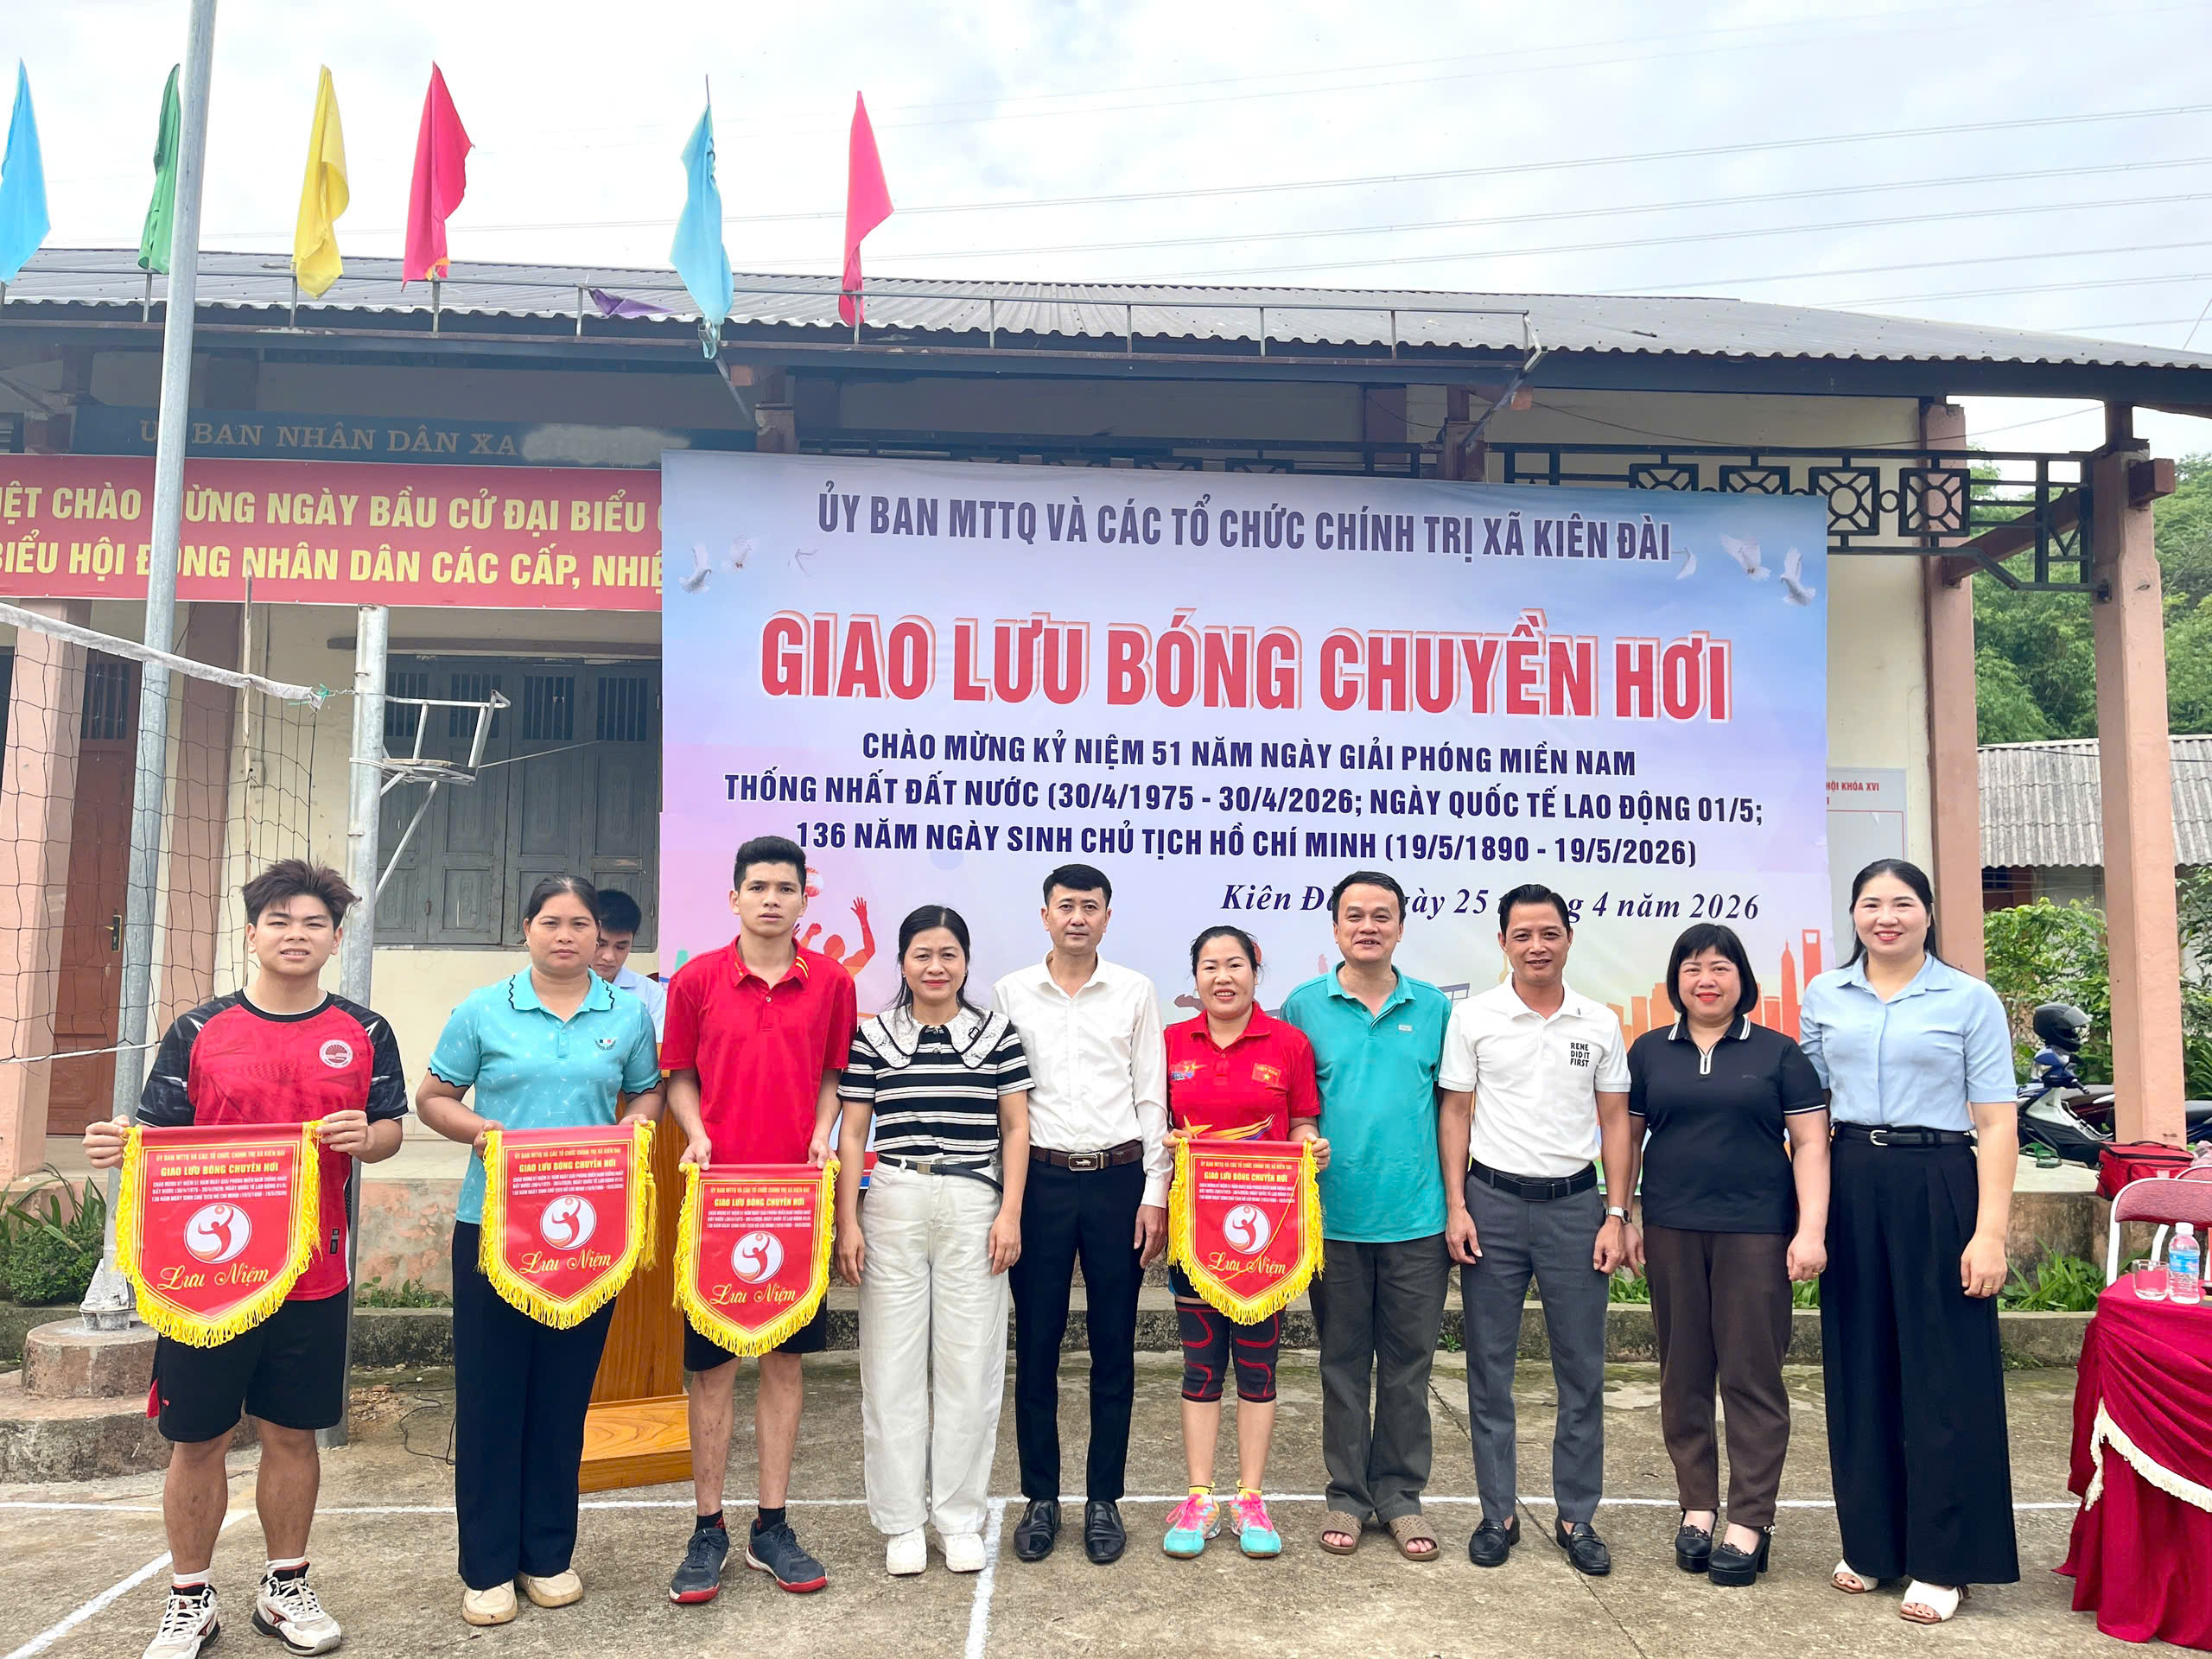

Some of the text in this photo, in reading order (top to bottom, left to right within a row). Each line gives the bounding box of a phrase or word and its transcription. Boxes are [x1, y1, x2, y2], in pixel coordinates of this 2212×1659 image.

[140, 420, 158, 442] U
[192, 423, 264, 446] BAN
[276, 422, 377, 450] NHÂN
[387, 423, 461, 454] DÂN
[0, 480, 42, 524] ỆT
[52, 481, 142, 521] CHÀO
[180, 484, 255, 523] ỪNG
[267, 487, 359, 526] NGÀY
[370, 486, 436, 529] BẦU
[448, 487, 497, 530] CỬ
[504, 499, 559, 537] ĐẠI
[570, 489, 646, 533] BIỂU
[819, 480, 1669, 563] ỦY BAN MTTQ VÀ CÁC TỔ CHỨC CHÍNH TRỊ XÃ KIÊN ĐÀI
[0, 529, 59, 574] IỂU
[69, 537, 124, 581] HỘI
[136, 543, 231, 578] ĐNG
[242, 541, 339, 581] NHÂN
[350, 543, 422, 582] DÂN
[432, 546, 498, 584] CÁC
[510, 543, 581, 589] CẤP,
[760, 608, 1732, 720] GIAO LƯU BÓNG CHUYỀN HƠI
[863, 728, 1635, 775] CHÀO MỪNG KỶ NIỆM 51 NĂM NGÀY GIẢI PHÓNG MIỀN NAM
[725, 766, 816, 802] THỐNG
[826, 769, 898, 804] NHẤT
[906, 771, 957, 804] ĐẤT
[965, 776, 1038, 807] NƯỚC
[1049, 783, 1193, 810] (30/4/1975
[1219, 786, 1361, 817] 30/4/2026;
[1370, 785, 1440, 815] NGÀY
[1450, 783, 1518, 818] QUỐC
[1527, 785, 1557, 817] TẾ
[1565, 794, 1611, 819] LAO
[1619, 791, 1689, 825] ĐỘNG
[1699, 798, 1761, 825] 01/5;
[1841, 781, 1864, 791] KHÓA
[1866, 782, 1879, 791] XVI
[798, 823, 845, 848] 136
[855, 818, 917, 849] NĂM
[926, 820, 999, 850] NGÀY
[1007, 826, 1071, 852] SINH
[1082, 820, 1133, 854] CHỦ
[1142, 830, 1201, 860] TỊCH
[1211, 823, 1243, 855] HỒ
[1254, 827, 1297, 856] CHÍ
[1306, 832, 1375, 858] MINH
[1386, 834, 1529, 861] (19/5/1890
[1555, 838, 1695, 868] 19/5/2026)
[1221, 885, 1290, 910] Kiên
[1404, 887, 1446, 920] ày
[1453, 889, 1488, 913] 25
[1592, 892, 1608, 916] 4
[1618, 893, 1679, 917] năm
[1689, 894, 1758, 919] 2026
[1570, 1042, 1589, 1051] RENE
[1570, 1058, 1589, 1067] FIRST
[161, 1166, 181, 1177] GIAO
[157, 1263, 270, 1291] Lưu Niệm
[520, 1249, 612, 1274] Lưu Niệm
[1208, 1252, 1287, 1277] Lưu Niệm
[710, 1283, 797, 1306] Lưu Niệm
